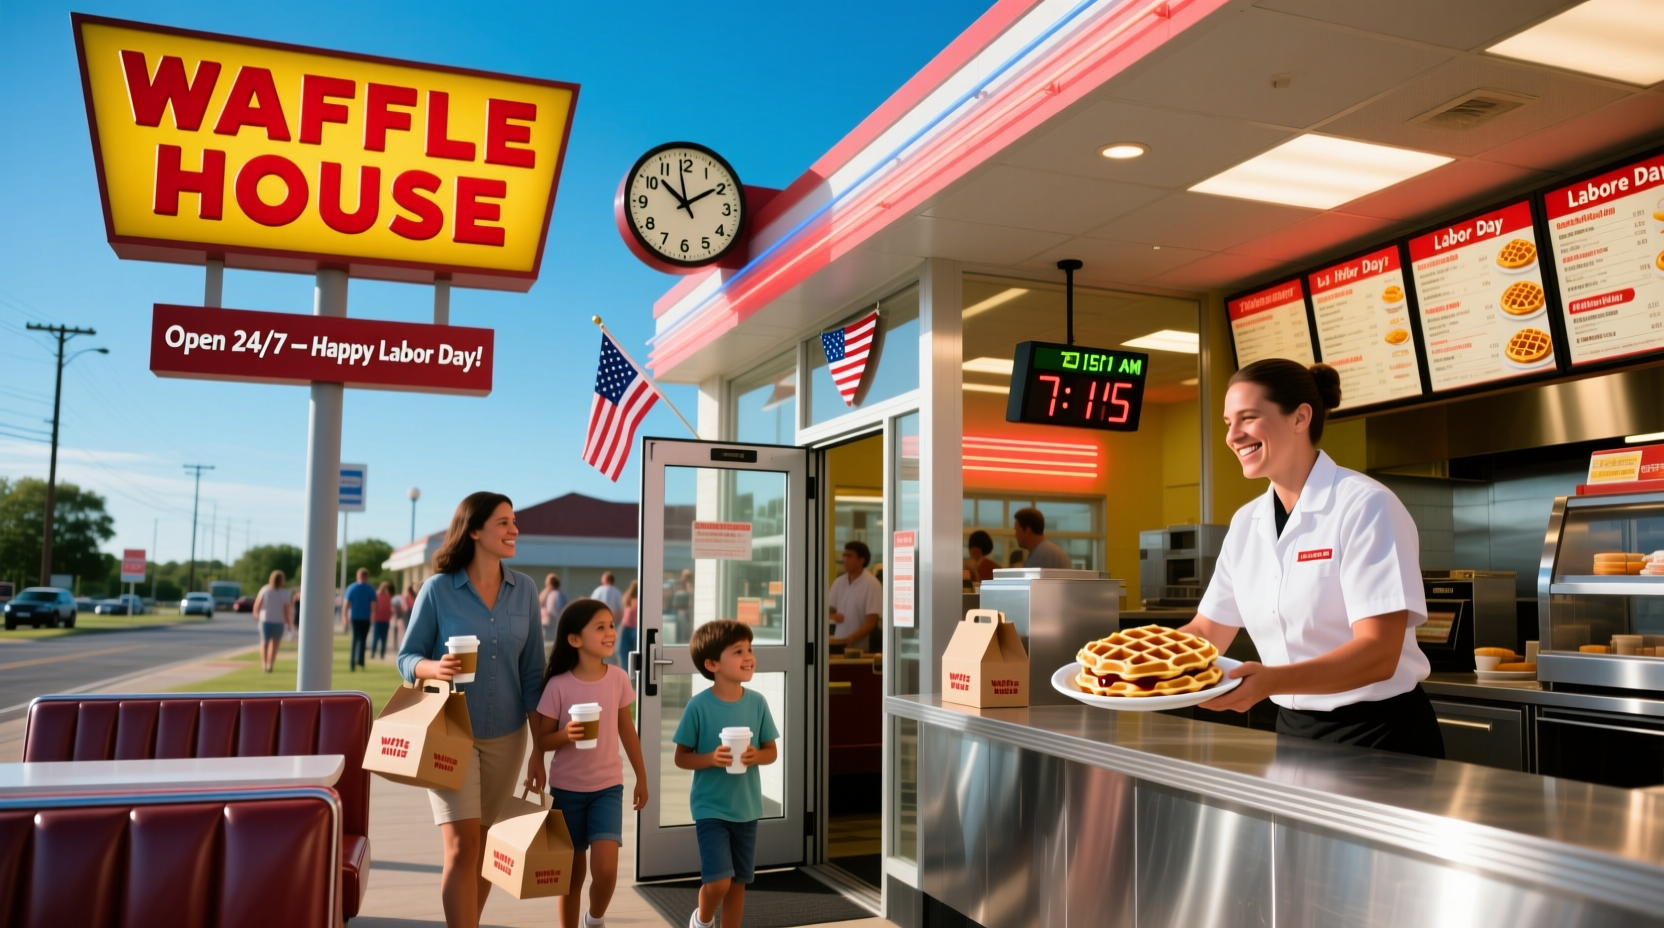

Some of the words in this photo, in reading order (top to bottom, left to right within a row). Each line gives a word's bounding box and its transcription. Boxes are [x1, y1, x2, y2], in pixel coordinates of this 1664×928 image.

[119, 49, 538, 170] WAFFLE
[660, 162, 671, 177] 11
[645, 175, 659, 190] 10
[715, 182, 727, 196] 2
[152, 143, 508, 248] HOUSE
[1567, 175, 1629, 209] Labore
[638, 195, 648, 209] 9
[722, 203, 731, 217] 3
[645, 216, 655, 231] 8
[714, 223, 725, 237] 4
[659, 232, 669, 245] 7
[1433, 227, 1473, 251] Labor
[1476, 218, 1504, 237] Day
[680, 240, 690, 253] 6
[701, 236, 711, 250] 5
[165, 324, 226, 356] Open
[231, 329, 288, 359] 24/7
[311, 335, 375, 367] Happy
[378, 339, 435, 365] Labor
[437, 343, 483, 373] Day!
